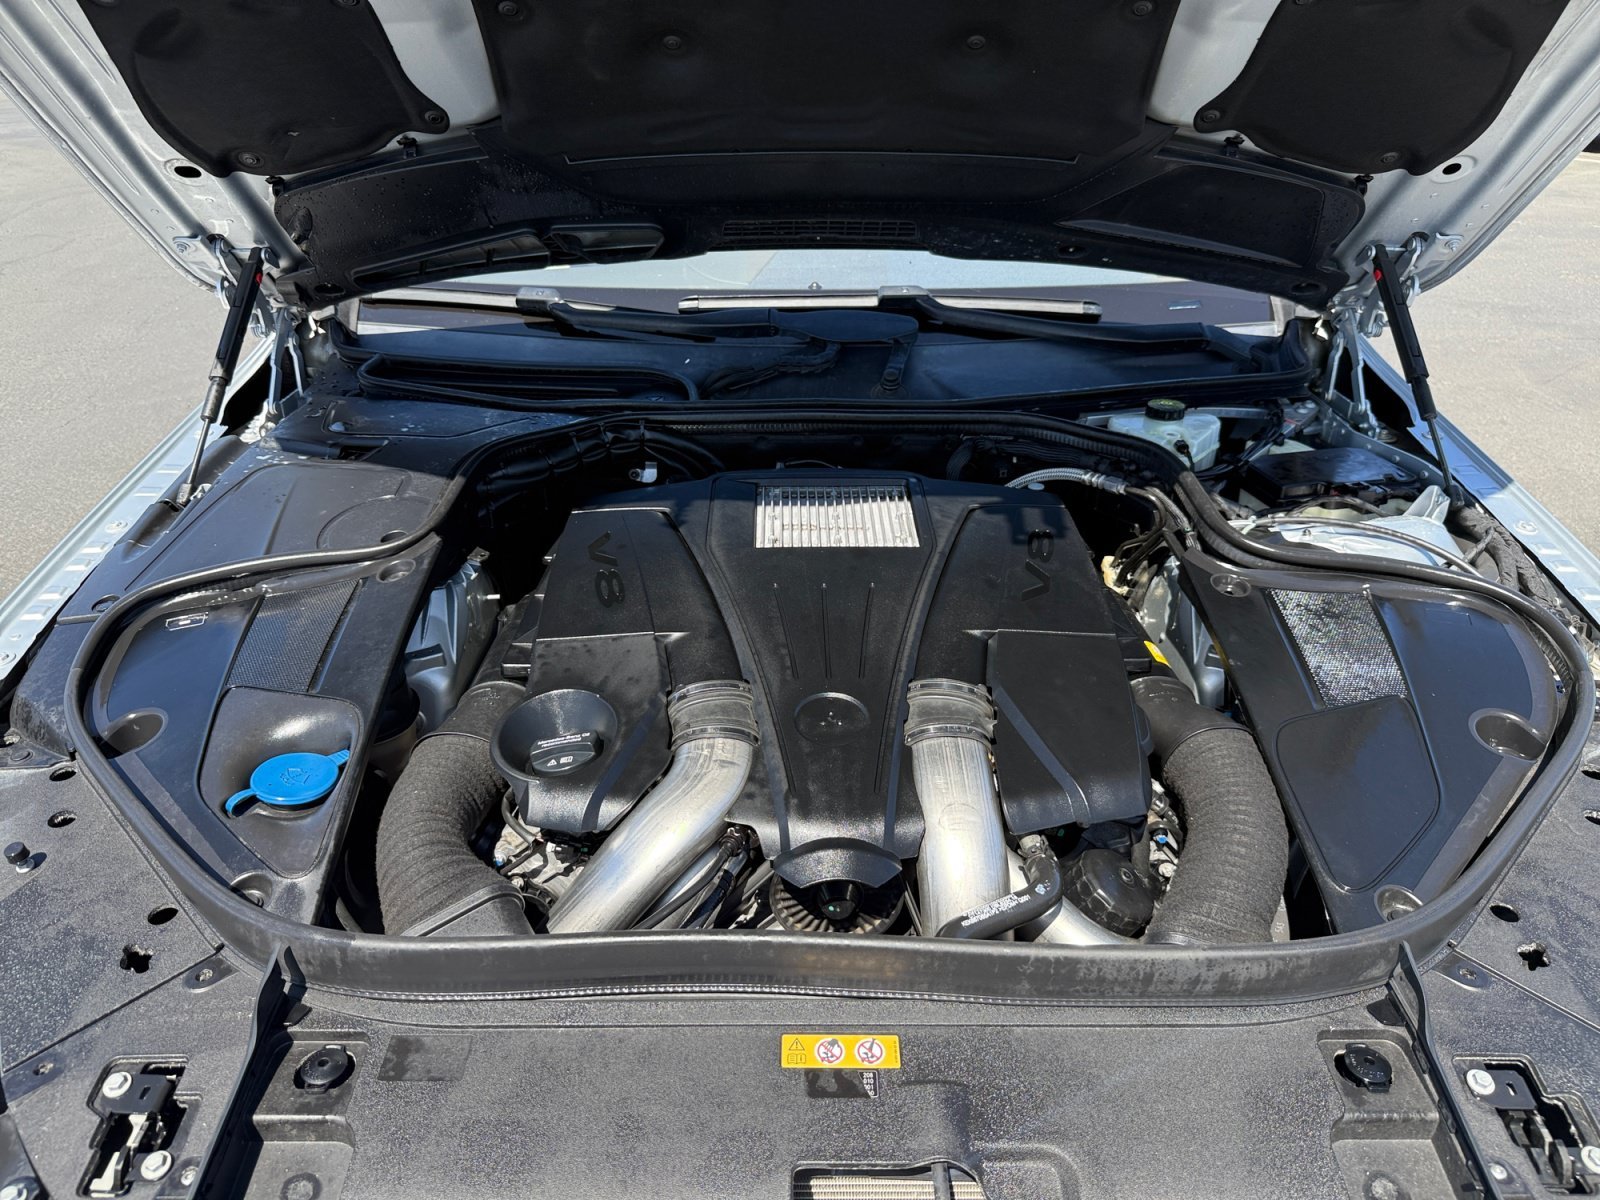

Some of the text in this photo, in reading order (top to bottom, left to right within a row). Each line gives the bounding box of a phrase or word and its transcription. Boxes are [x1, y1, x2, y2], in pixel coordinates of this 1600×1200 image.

[587, 531, 625, 608] V8
[1020, 529, 1054, 602] V8
[537, 733, 581, 746] Mercedes-Benz
